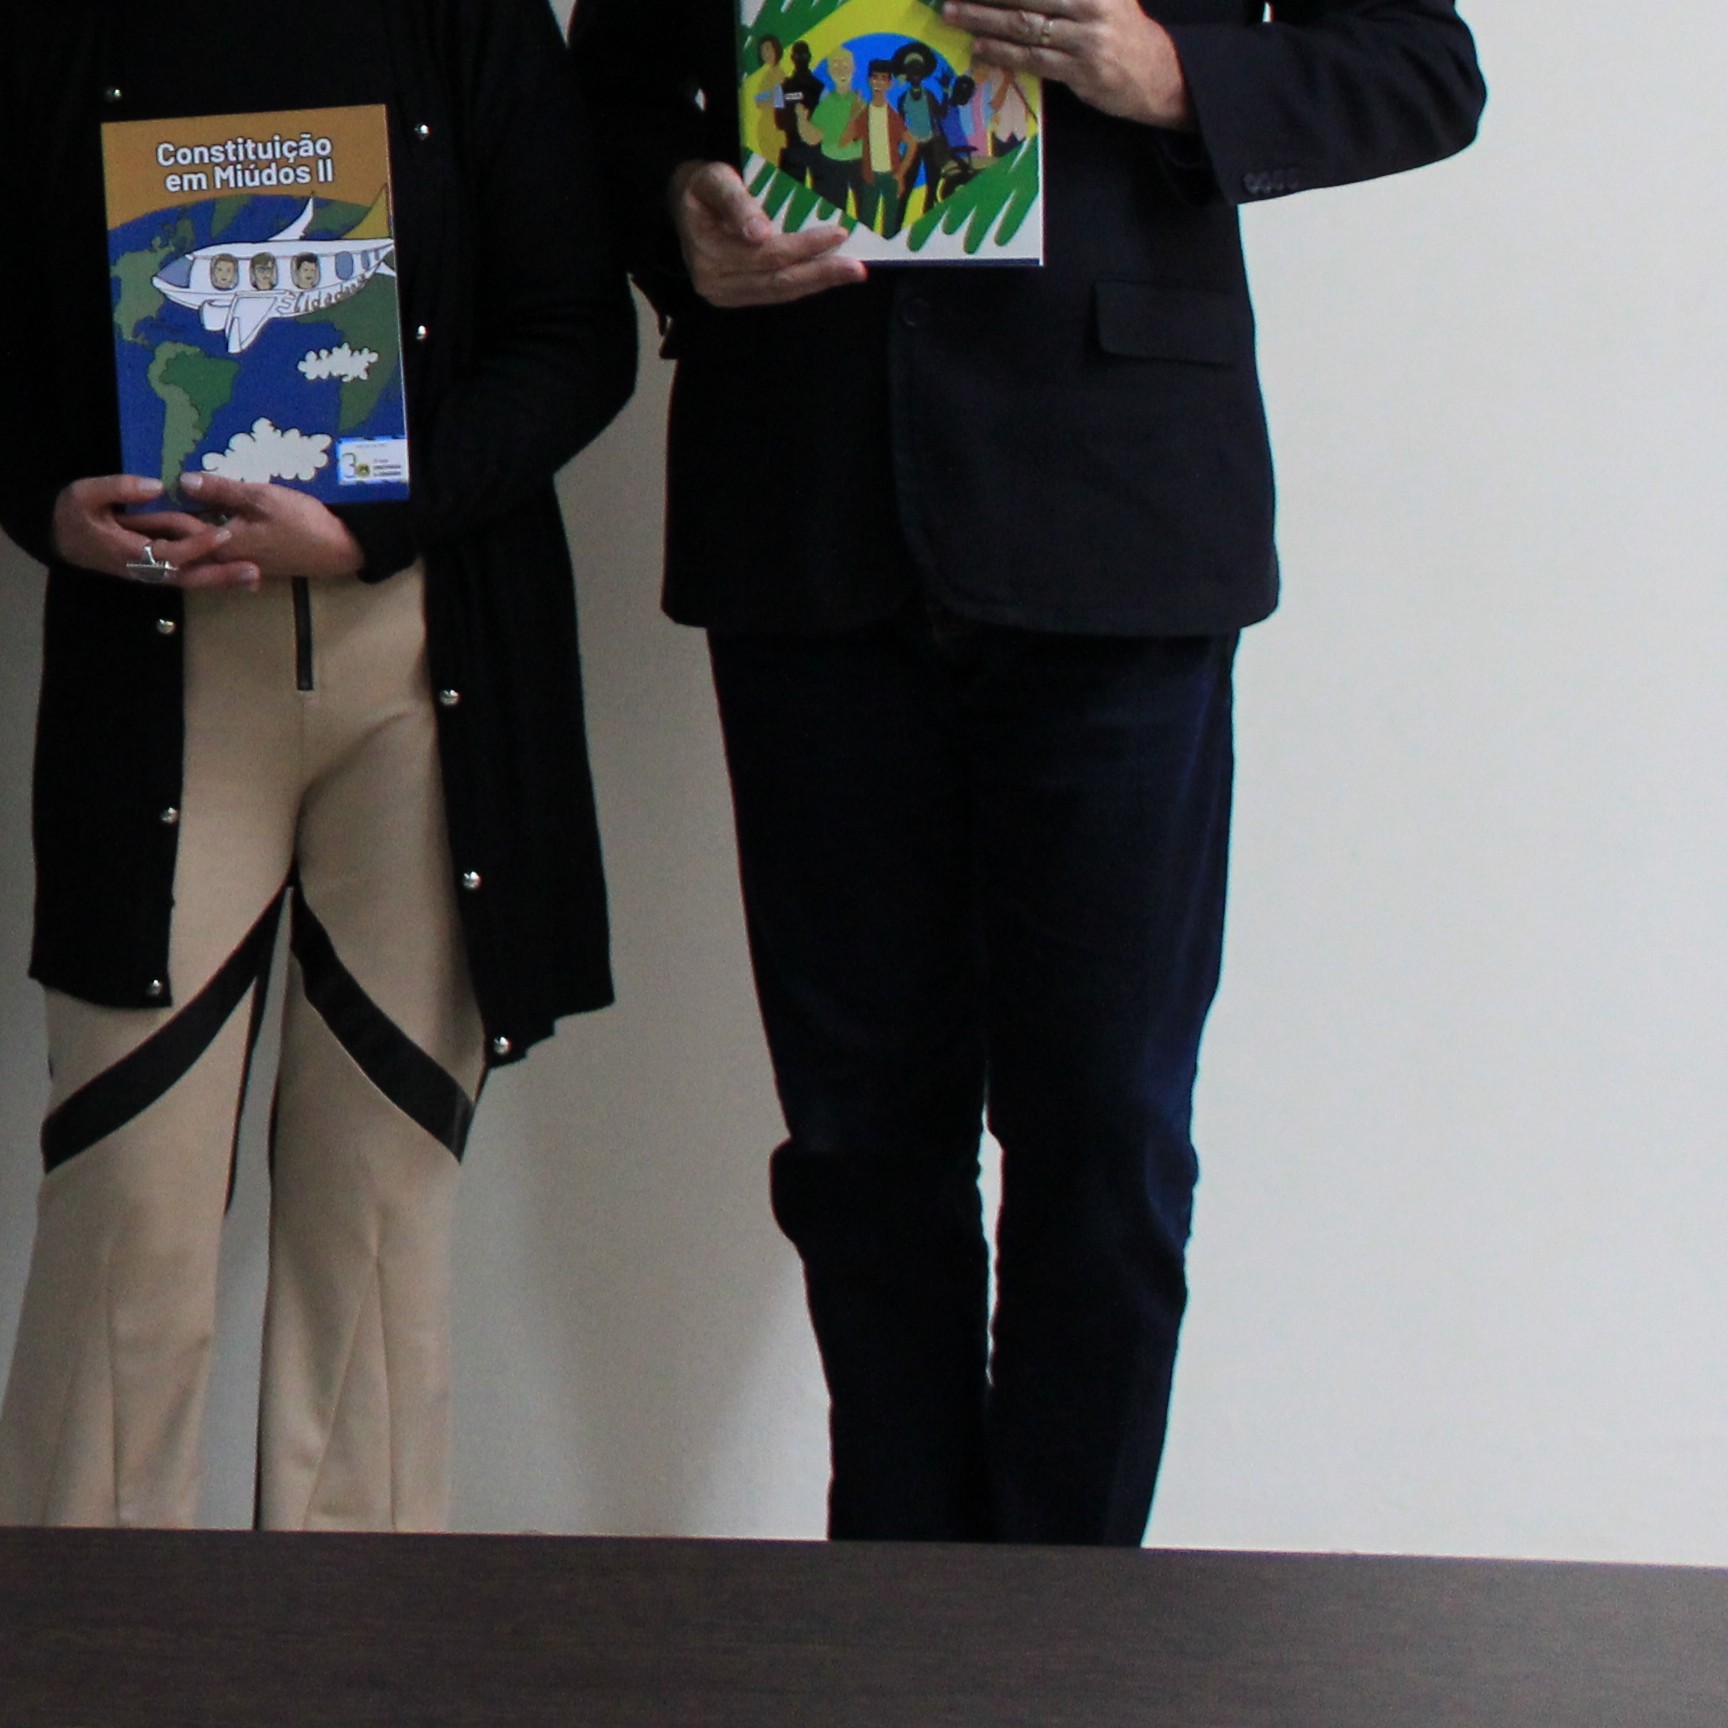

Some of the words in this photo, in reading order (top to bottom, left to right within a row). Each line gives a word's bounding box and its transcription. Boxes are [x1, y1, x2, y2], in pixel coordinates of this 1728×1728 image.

[156, 132, 332, 166] Constituição
[164, 172, 208, 192] em
[213, 161, 311, 189] Miúdos
[317, 158, 334, 183] II
